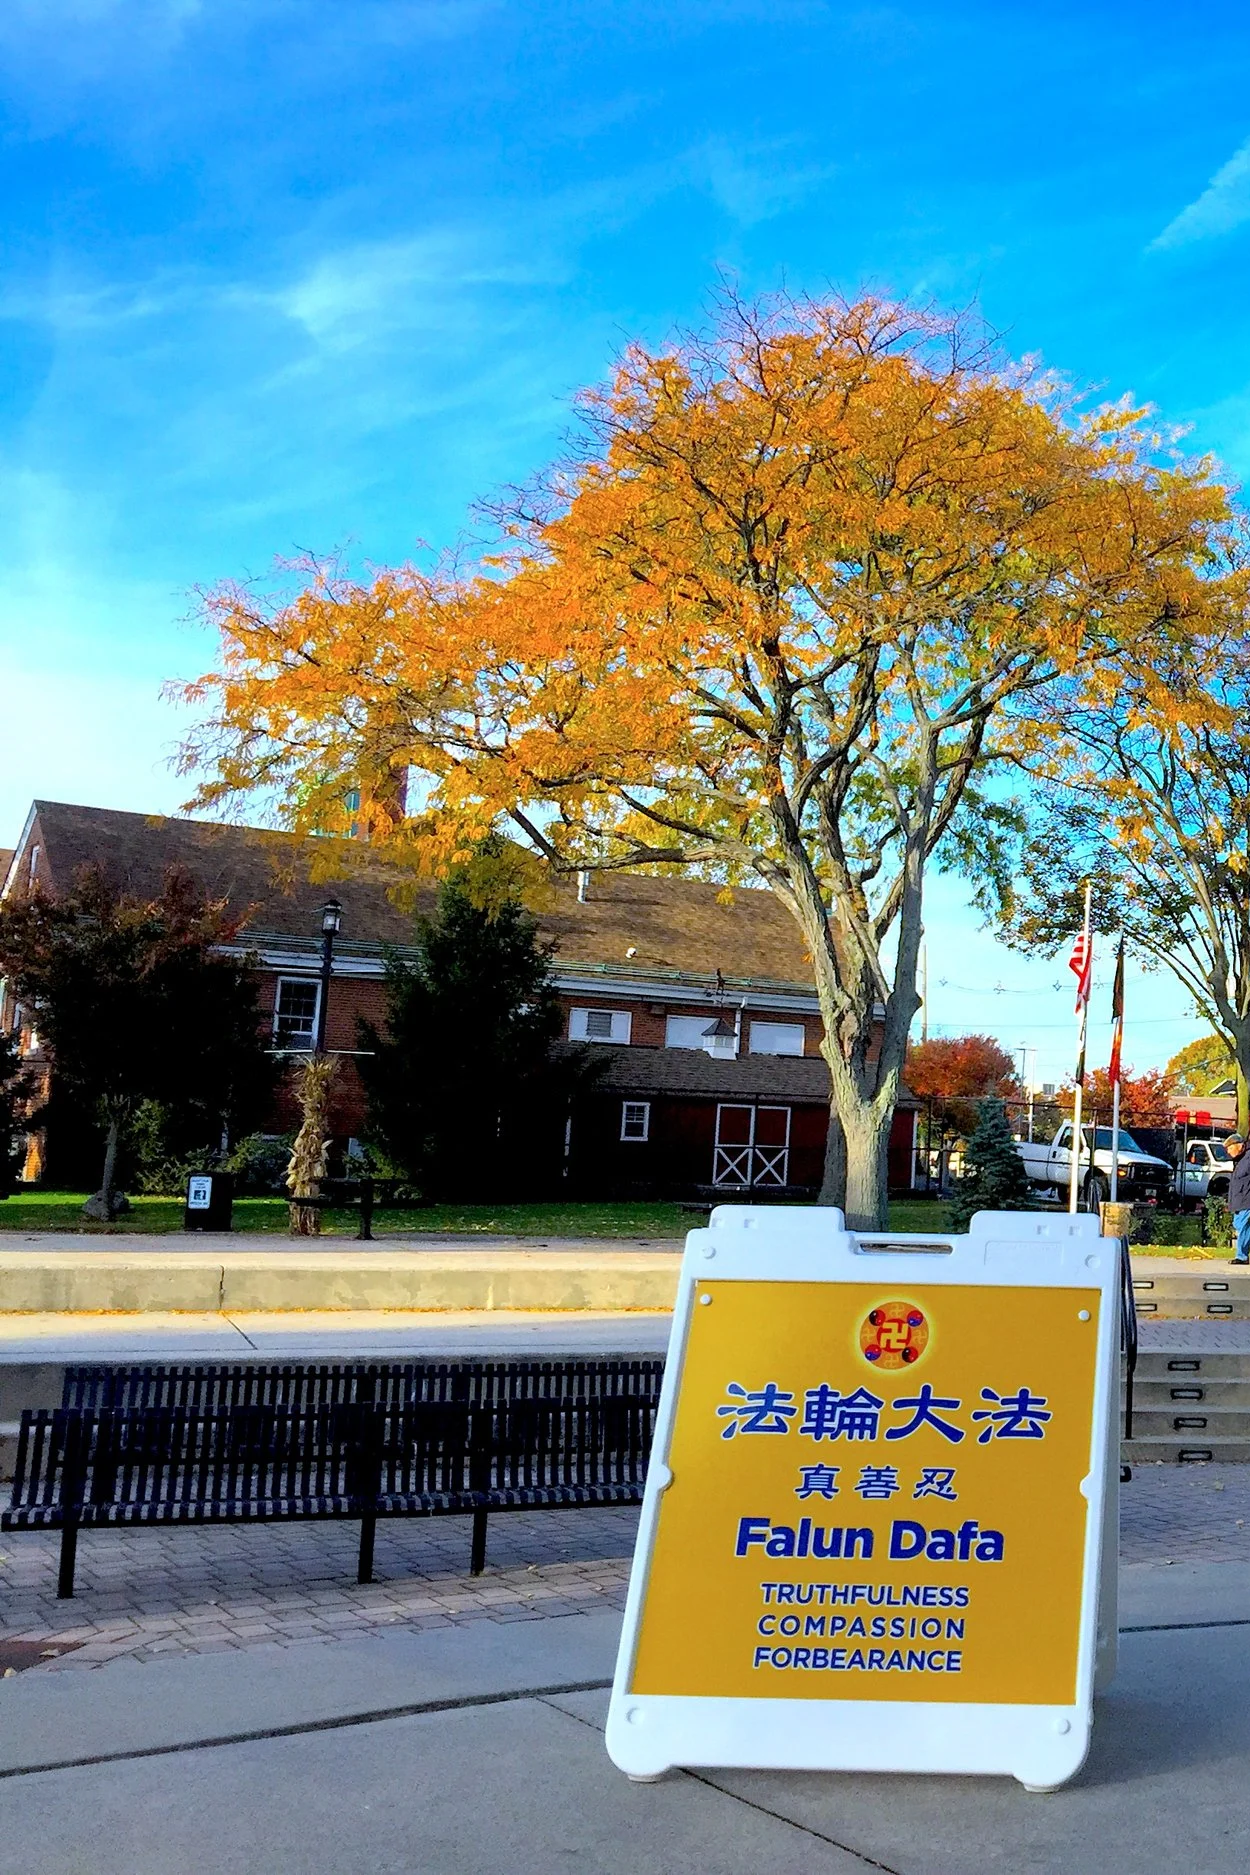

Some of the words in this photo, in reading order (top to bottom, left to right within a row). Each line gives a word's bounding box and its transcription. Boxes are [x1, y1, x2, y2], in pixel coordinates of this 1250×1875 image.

[717, 1384, 1052, 1443] 法輪大法
[795, 1463, 958, 1501] 真善忍
[735, 1517, 874, 1558] Falun
[889, 1519, 1005, 1561] Dafa
[761, 1583, 970, 1607] TRUTHFULNESS
[758, 1614, 965, 1639] COMPASSION
[753, 1646, 962, 1671] FORBEARANCE
